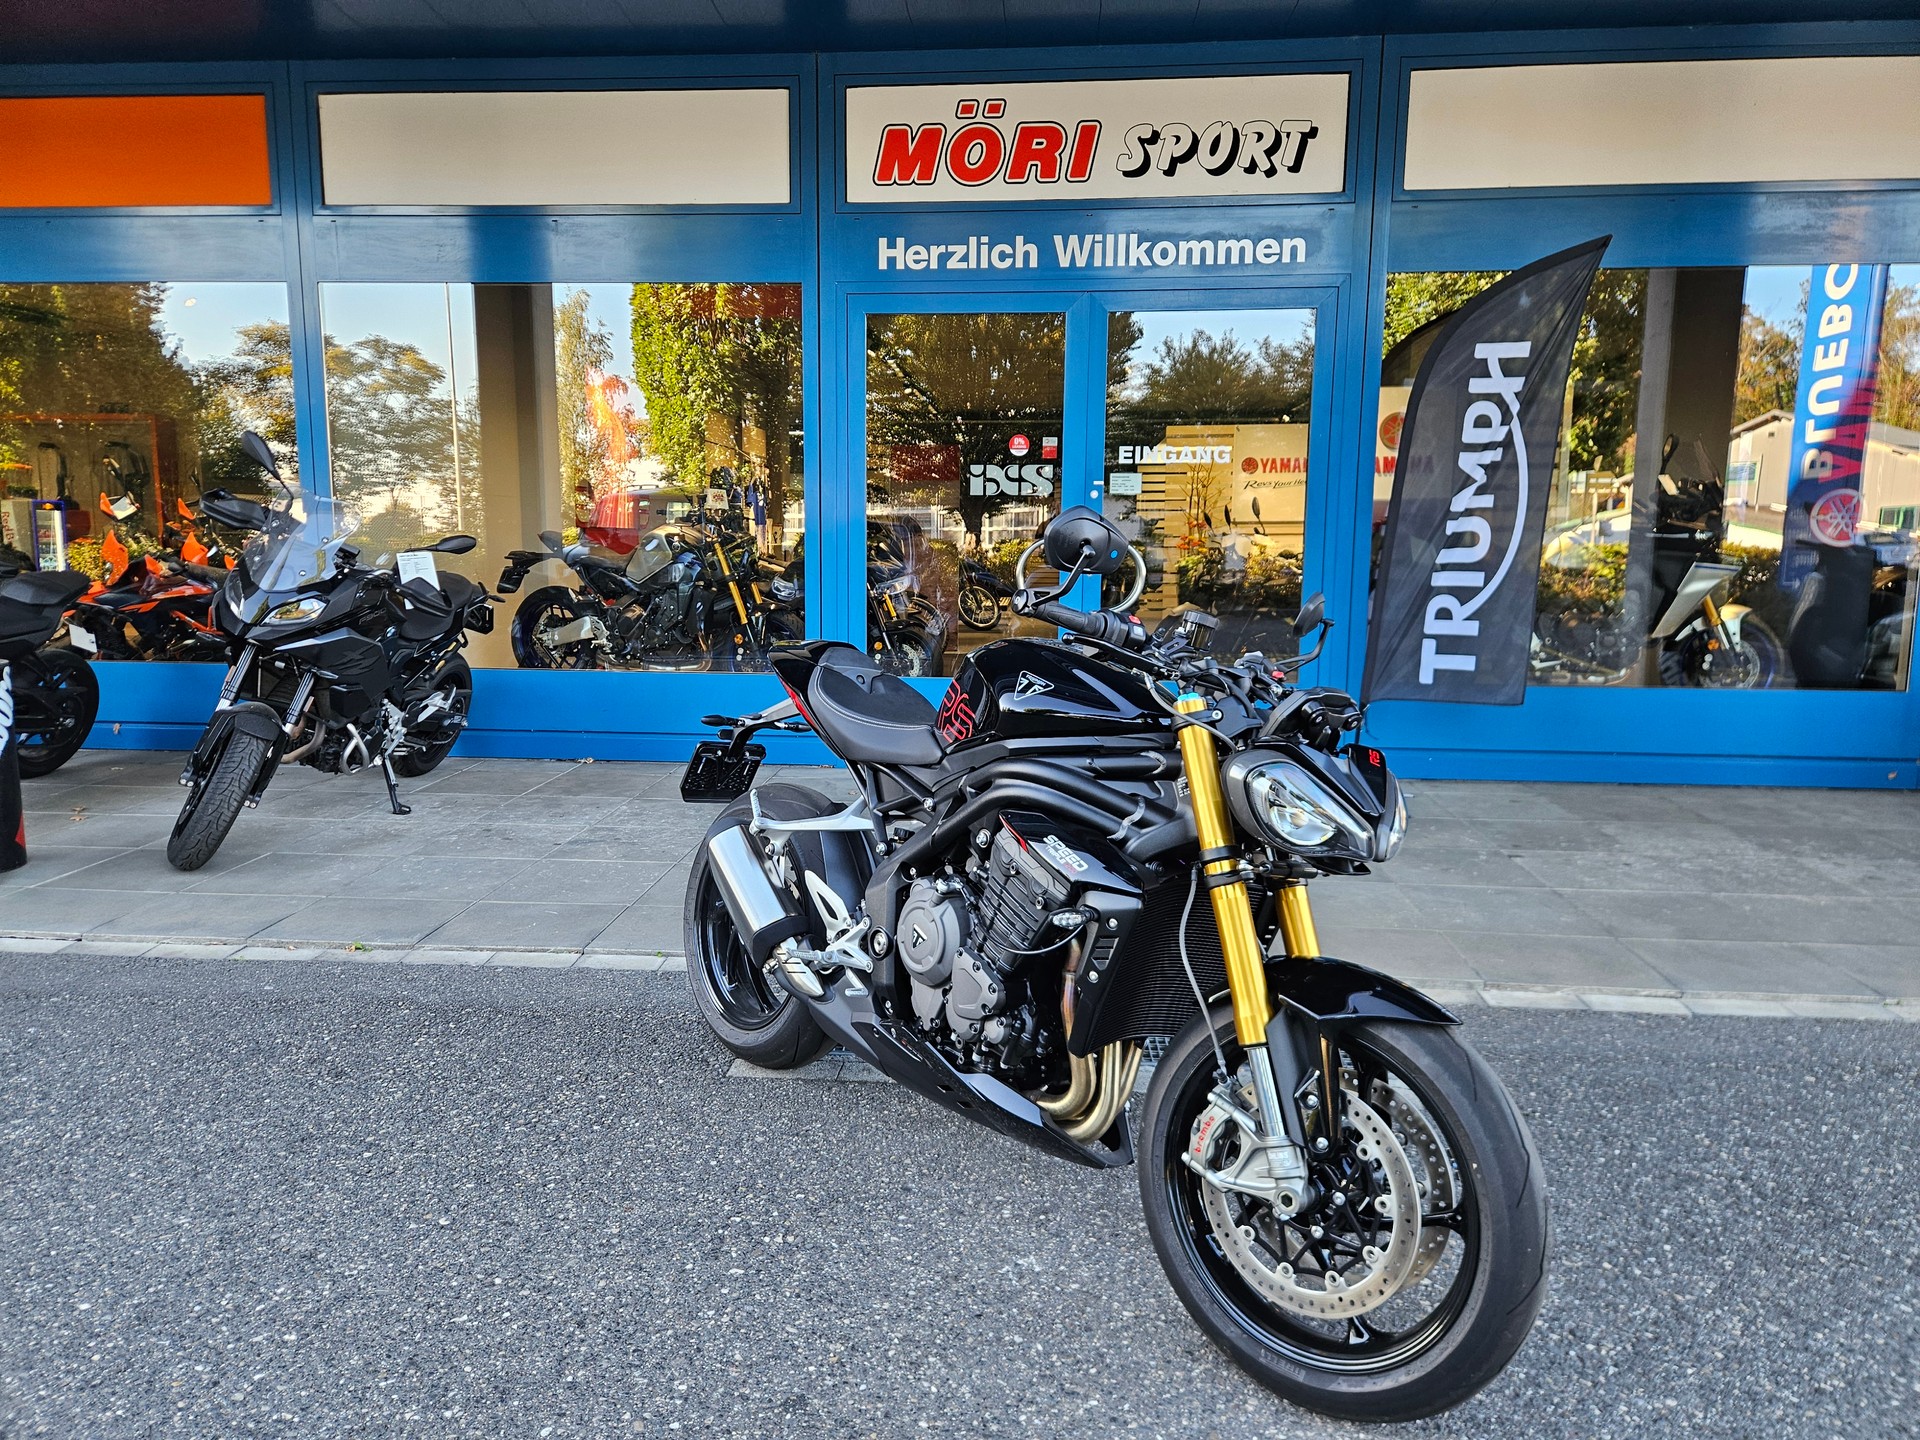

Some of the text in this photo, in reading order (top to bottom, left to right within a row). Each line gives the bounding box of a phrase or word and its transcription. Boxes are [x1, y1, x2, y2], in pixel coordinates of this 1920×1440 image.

[872, 98, 1320, 187] MÖRI SPORT
[877, 233, 1307, 270] Herzlich Willkommen
[1118, 445, 1231, 464] EINGANG
[1418, 341, 1532, 685] TRIUMPH
[1043, 834, 1089, 872] SPEED
[1193, 1115, 1216, 1154] brembo
